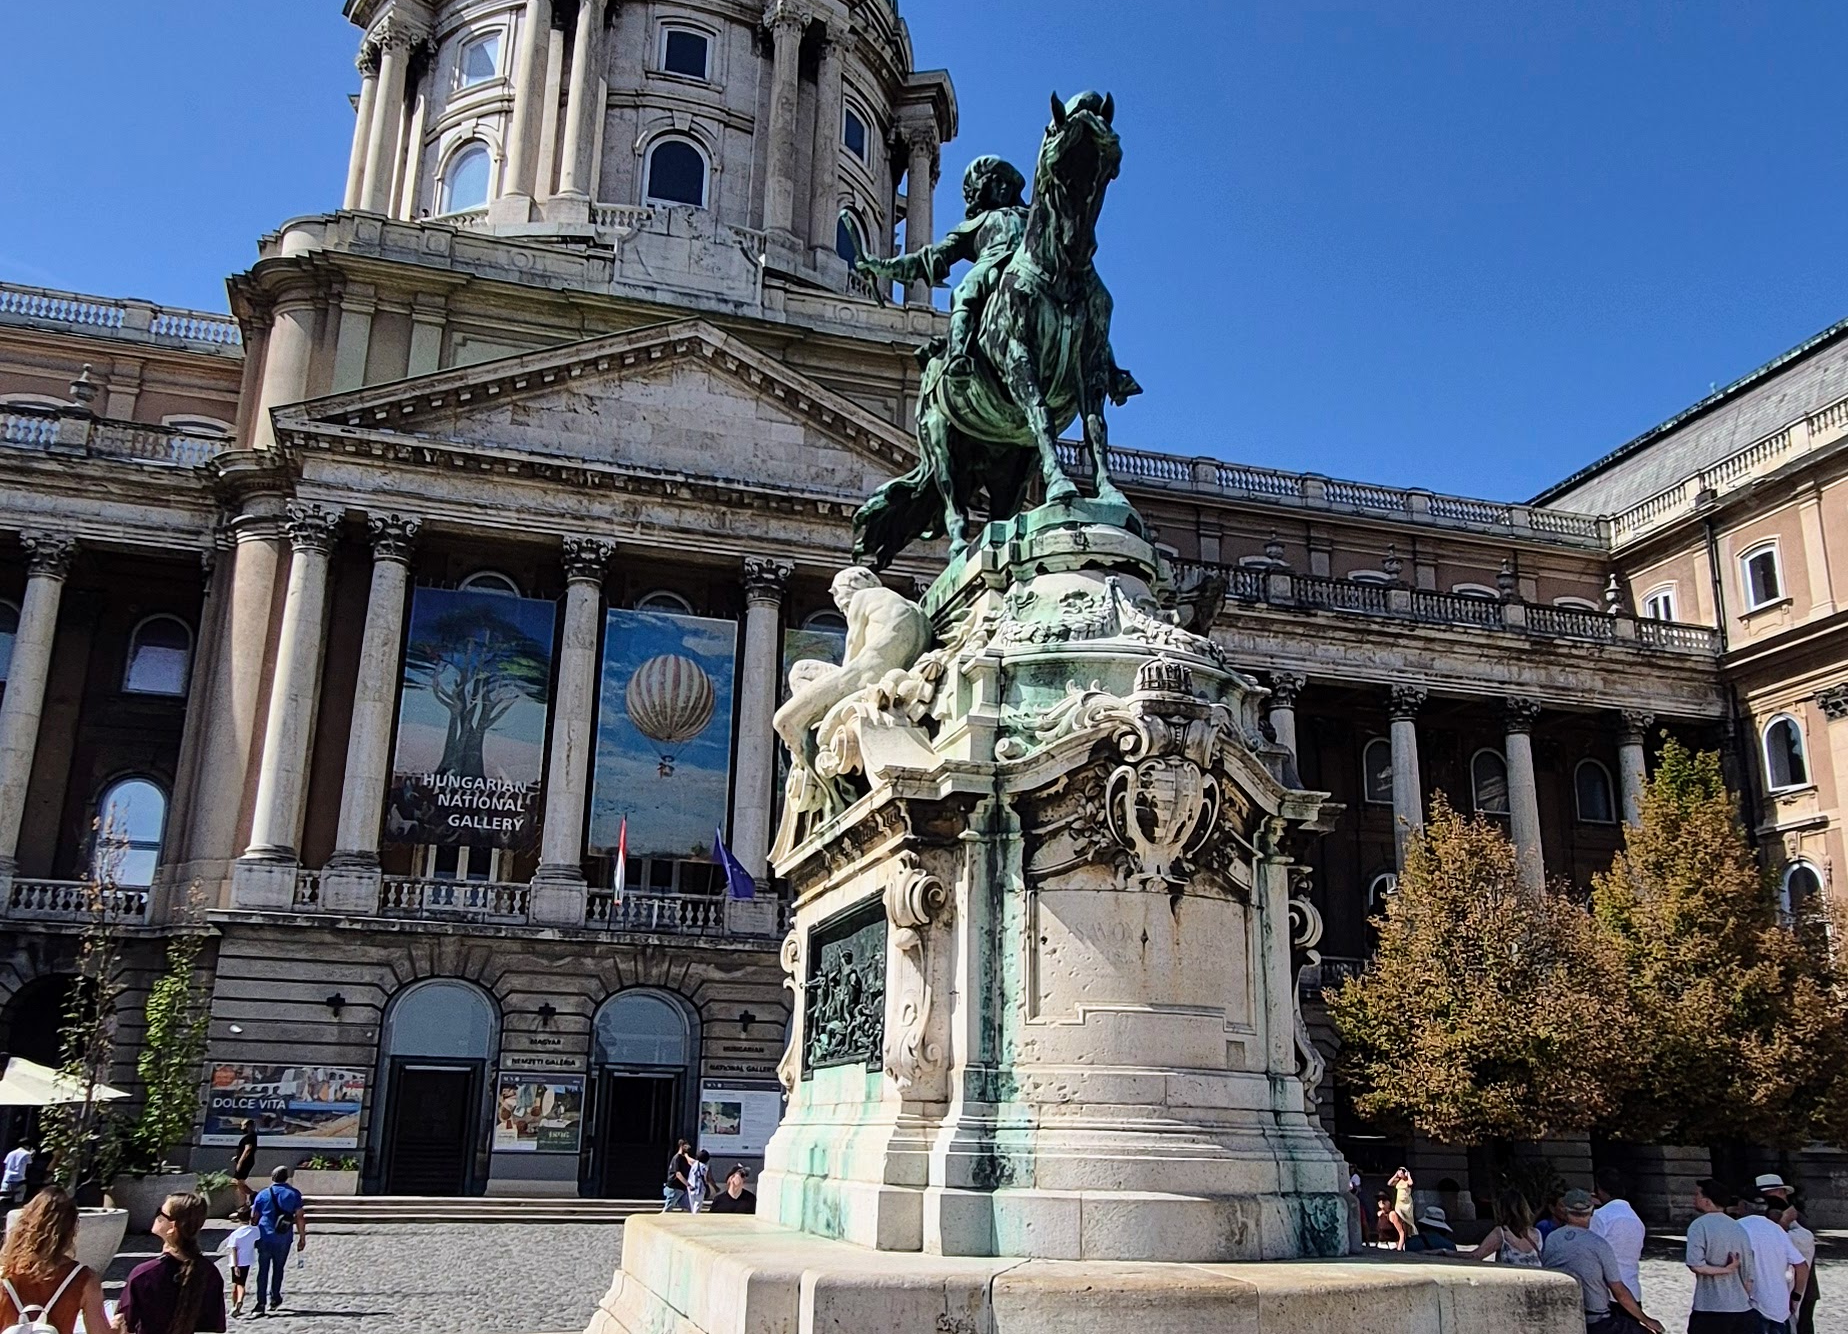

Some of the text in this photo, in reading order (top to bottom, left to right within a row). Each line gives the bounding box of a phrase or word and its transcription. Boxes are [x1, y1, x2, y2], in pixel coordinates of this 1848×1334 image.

[422, 773, 527, 793] HUNGARIAN
[438, 794, 526, 812] NATIONAL
[447, 814, 525, 831] GALLERY
[511, 1057, 543, 1066] NEMZETI
[709, 1064, 744, 1073] NATIONAL
[212, 1097, 286, 1110] DOLCE VITA
